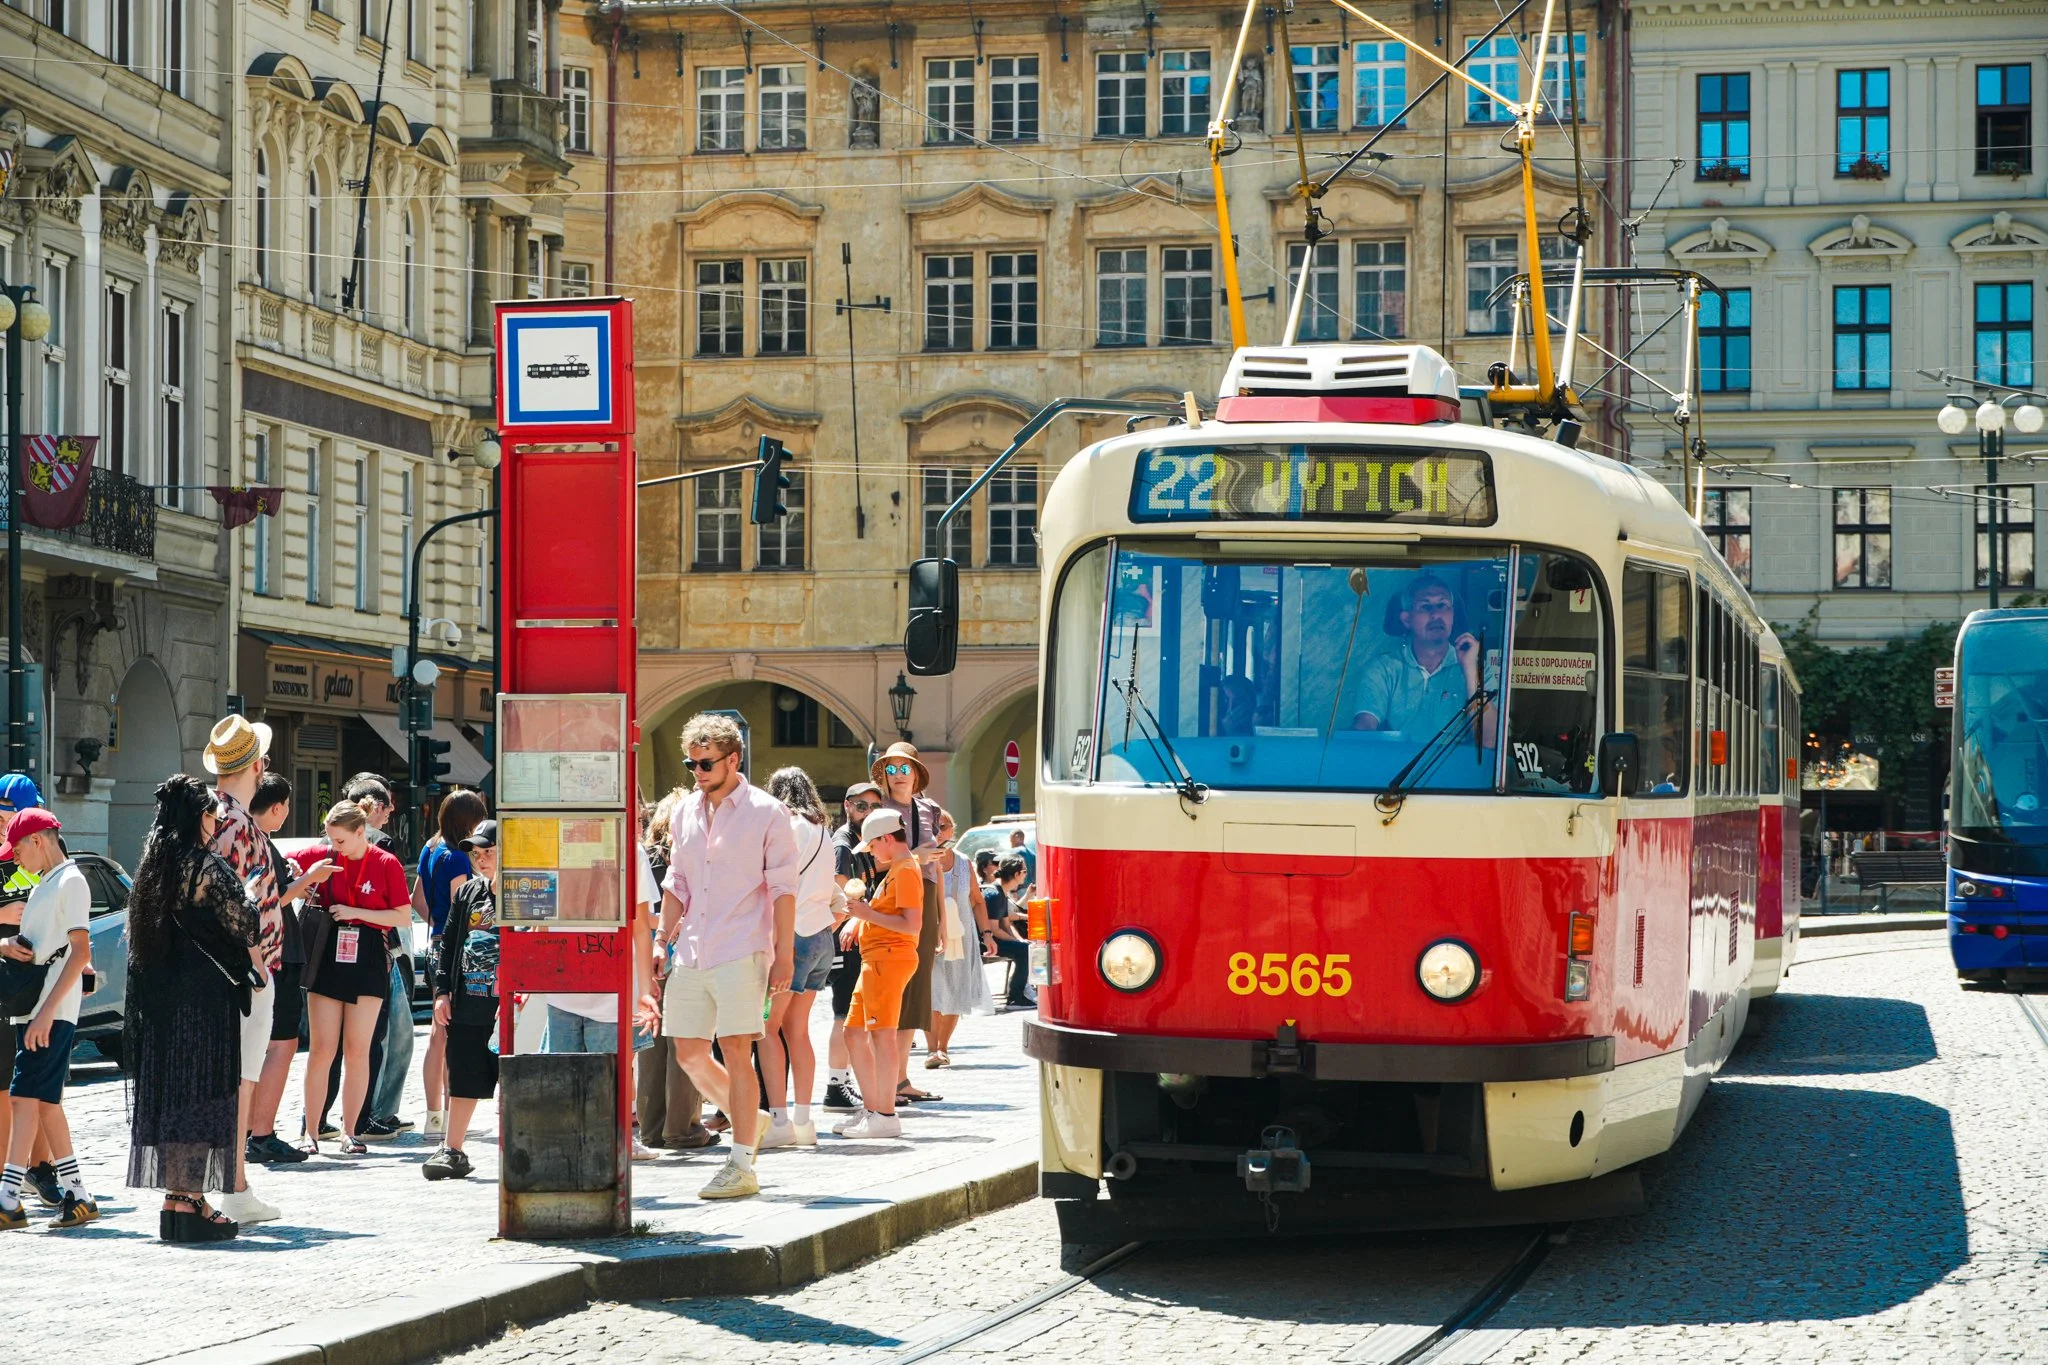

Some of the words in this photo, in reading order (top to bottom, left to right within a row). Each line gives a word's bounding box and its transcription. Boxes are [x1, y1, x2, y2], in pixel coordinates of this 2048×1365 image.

[1148, 453, 1227, 510] 22
[1262, 460, 1450, 512] VYPICH
[1535, 657, 1540, 667] S
[1541, 656, 1592, 669] ODPOJOVAČEM
[272, 680, 309, 697] RESIDENCE
[323, 669, 354, 703] gelato
[1515, 672, 1551, 684] STAŽENÝM
[1552, 673, 1585, 686] SBĚRAČE
[1073, 735, 1091, 765] 512
[1512, 742, 1544, 773] 512
[1227, 951, 1353, 997] 8565
